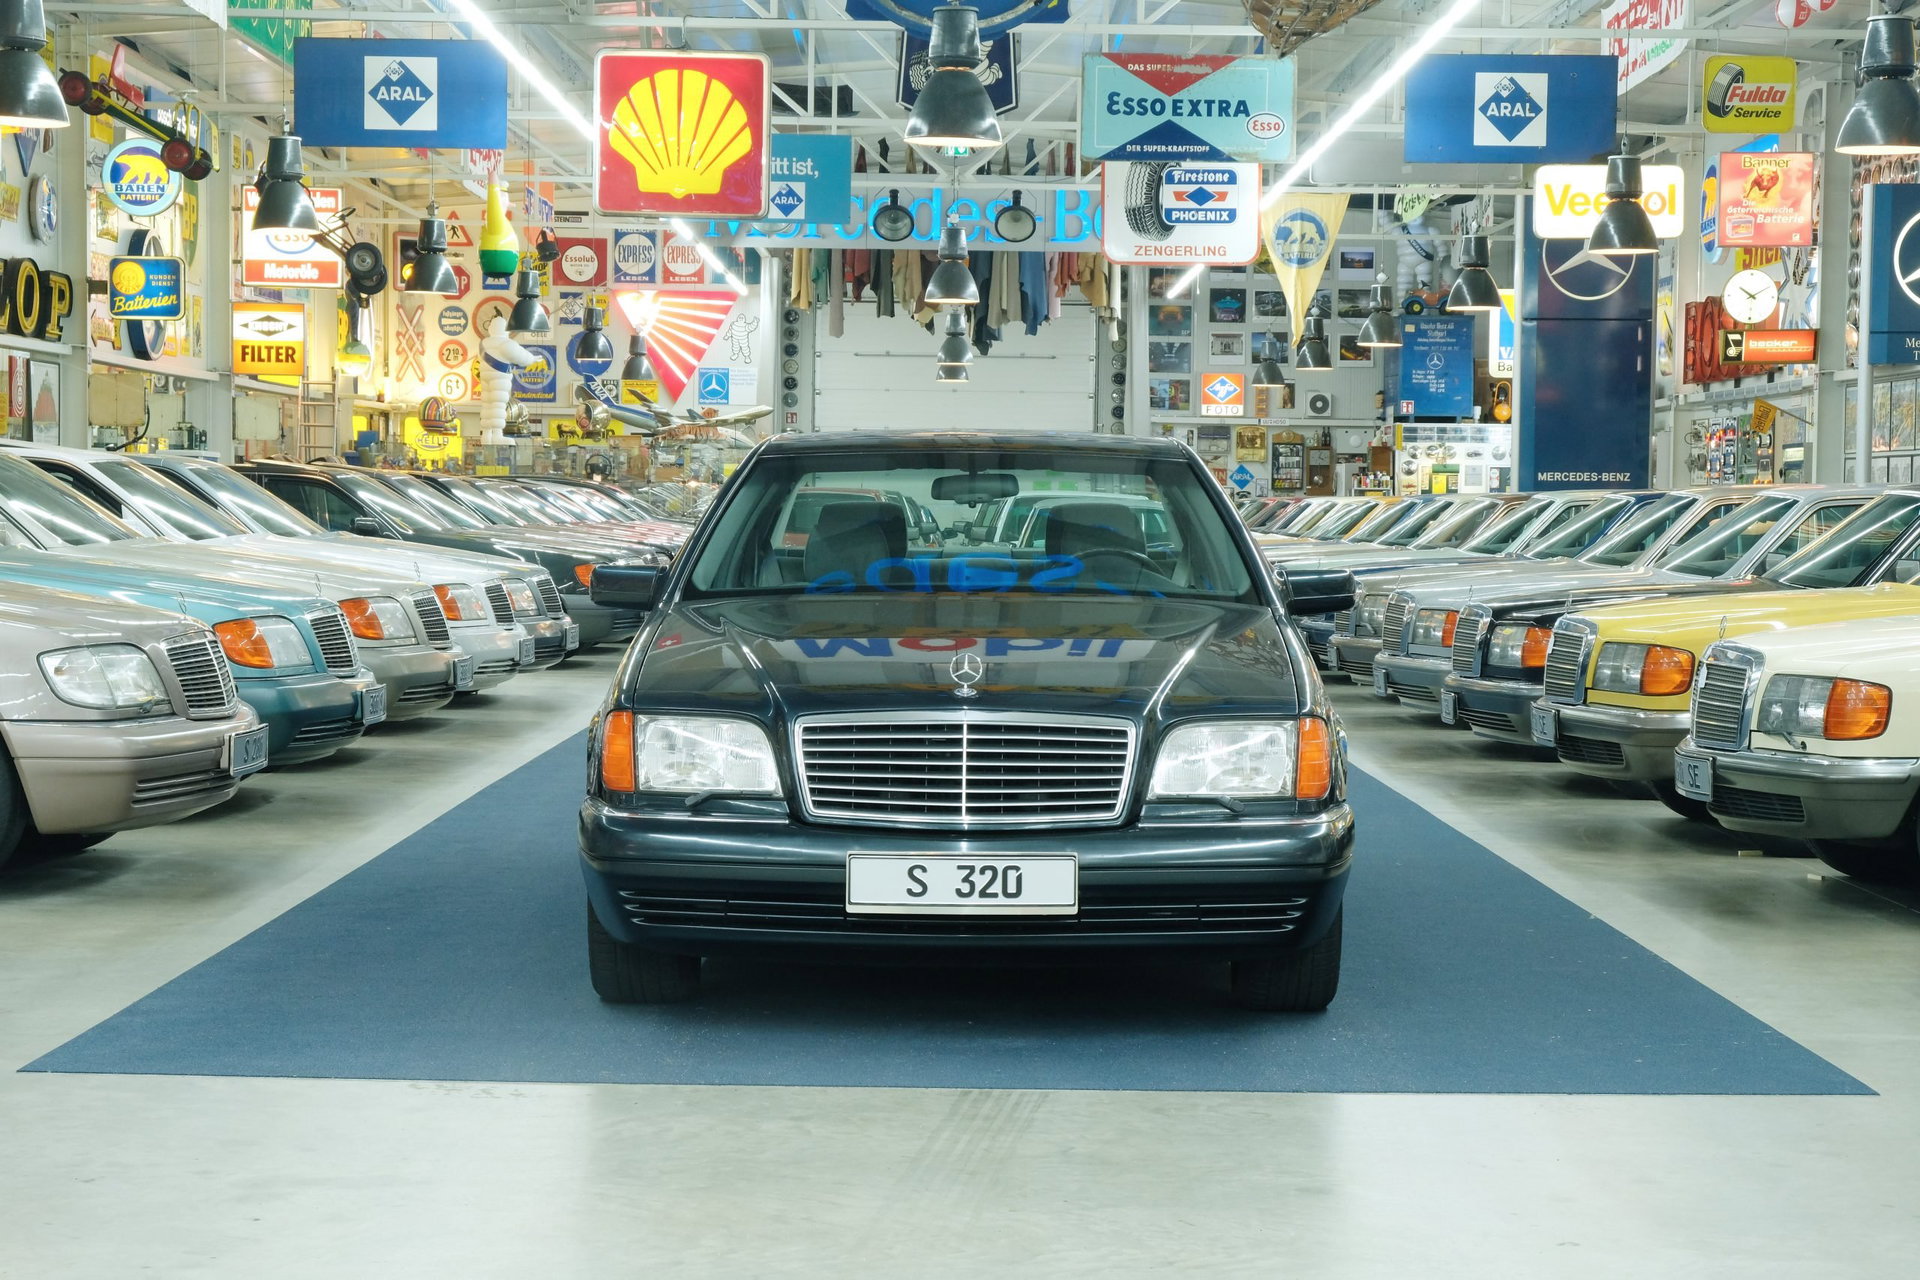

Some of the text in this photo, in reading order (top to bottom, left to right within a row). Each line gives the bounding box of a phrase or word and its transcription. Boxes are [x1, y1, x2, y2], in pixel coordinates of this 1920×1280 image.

[376, 85, 426, 101] ARAL
[1727, 85, 1787, 103] Fulda
[1171, 99, 1250, 118] EXTRA
[1486, 102, 1536, 117] ARAL
[1734, 107, 1781, 118] Service
[1126, 144, 1210, 153] DER SUPER-KRAFTSTOFF
[771, 157, 819, 178] itt ist,
[1742, 156, 1791, 168] Banner
[1171, 170, 1230, 183] Firestone
[114, 183, 165, 193] BÄREN
[773, 195, 800, 205] ARAL
[1544, 183, 1677, 216] Veeol
[1171, 210, 1230, 221] PHOENIX
[1756, 213, 1804, 224] Batterie
[564, 254, 596, 262] Essolub
[618, 244, 653, 263] EXPRESS
[666, 245, 701, 264] EXPRESS
[1134, 245, 1227, 256] ZENGERLING
[263, 262, 319, 280] Motoröle
[112, 291, 178, 313] Batterien
[240, 344, 297, 363] FILTER
[445, 347, 452, 361] 2
[445, 379, 453, 395] 6
[1206, 405, 1240, 415] FOTO
[1232, 472, 1252, 480] ARAL
[1538, 471, 1631, 482] MERCEDES-BENZ
[243, 737, 250, 764] S
[1687, 763, 1701, 790] SE
[906, 864, 1023, 899] S 320
